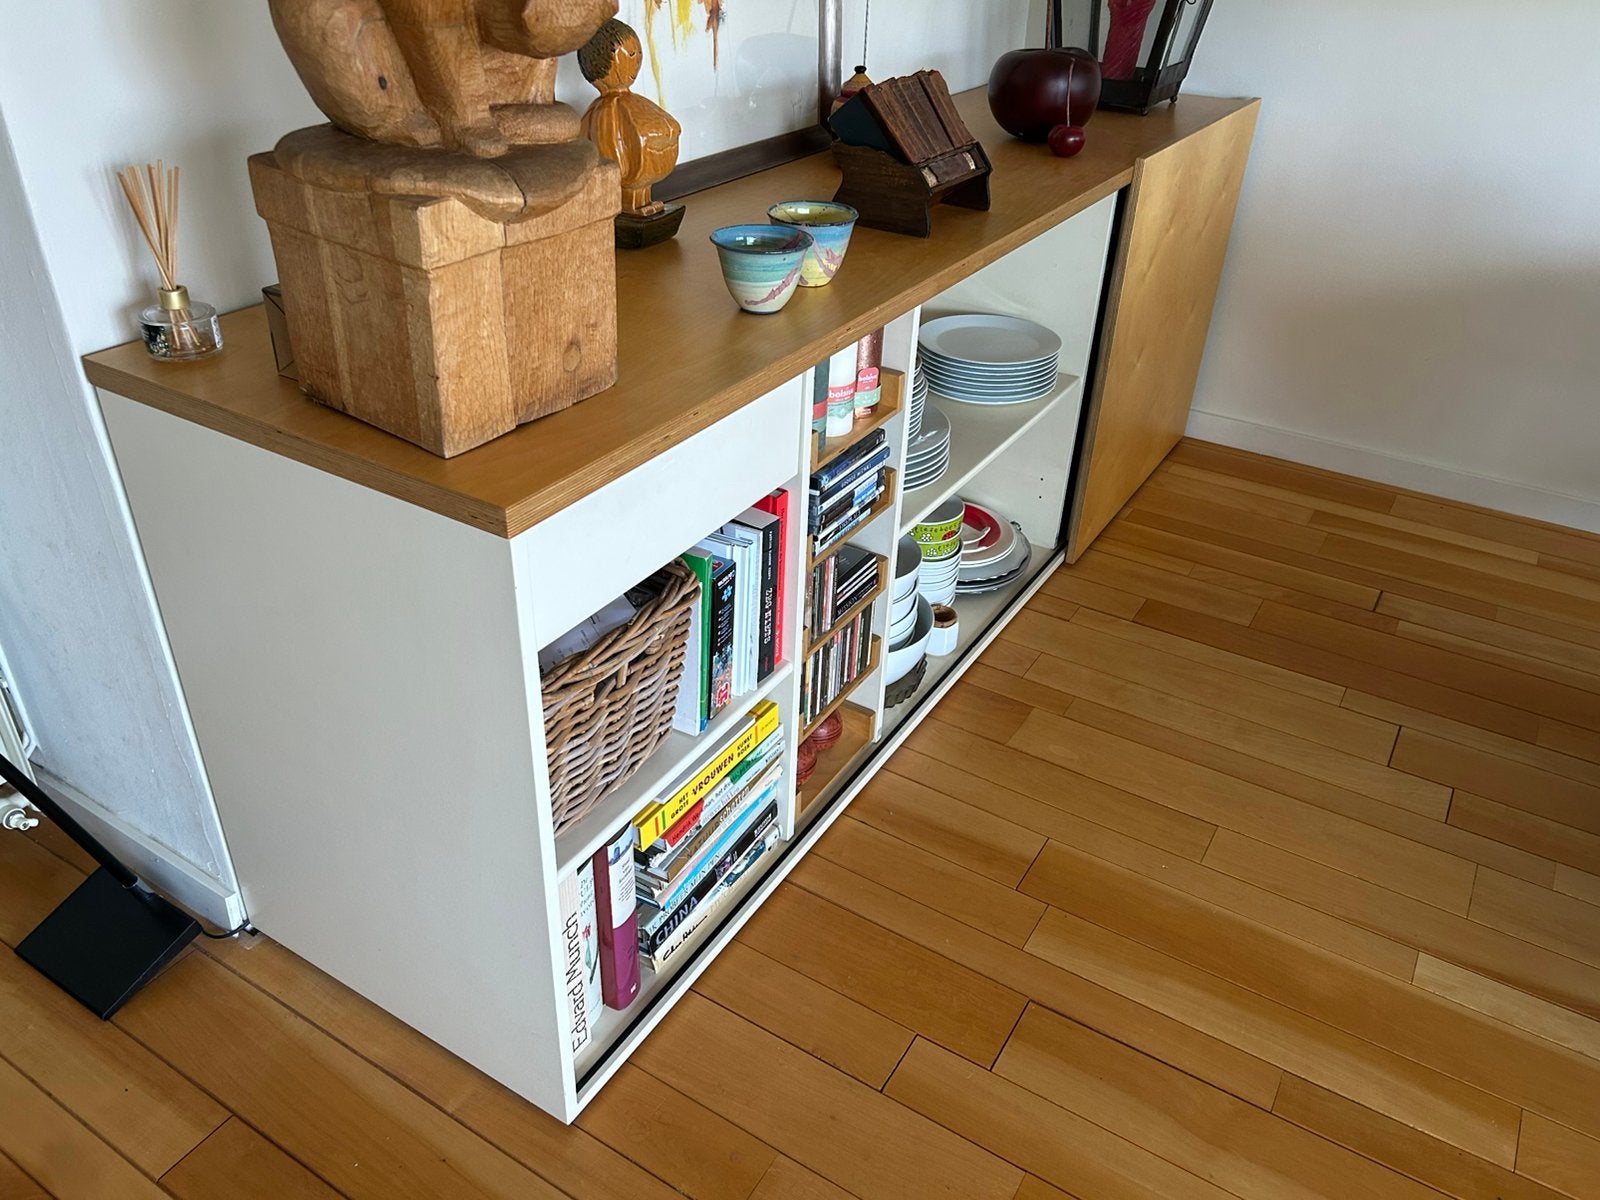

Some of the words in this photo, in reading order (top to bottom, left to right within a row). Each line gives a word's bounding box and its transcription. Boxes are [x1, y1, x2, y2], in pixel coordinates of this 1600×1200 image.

[736, 733, 752, 751] KUNST
[737, 742, 750, 757] BOEK
[691, 752, 735, 796] VROUWEN
[670, 798, 689, 819] GROTE
[678, 791, 689, 804] HET
[655, 896, 699, 946] CHINA
[566, 911, 582, 985] Munch
[568, 980, 588, 1052] Edvard
